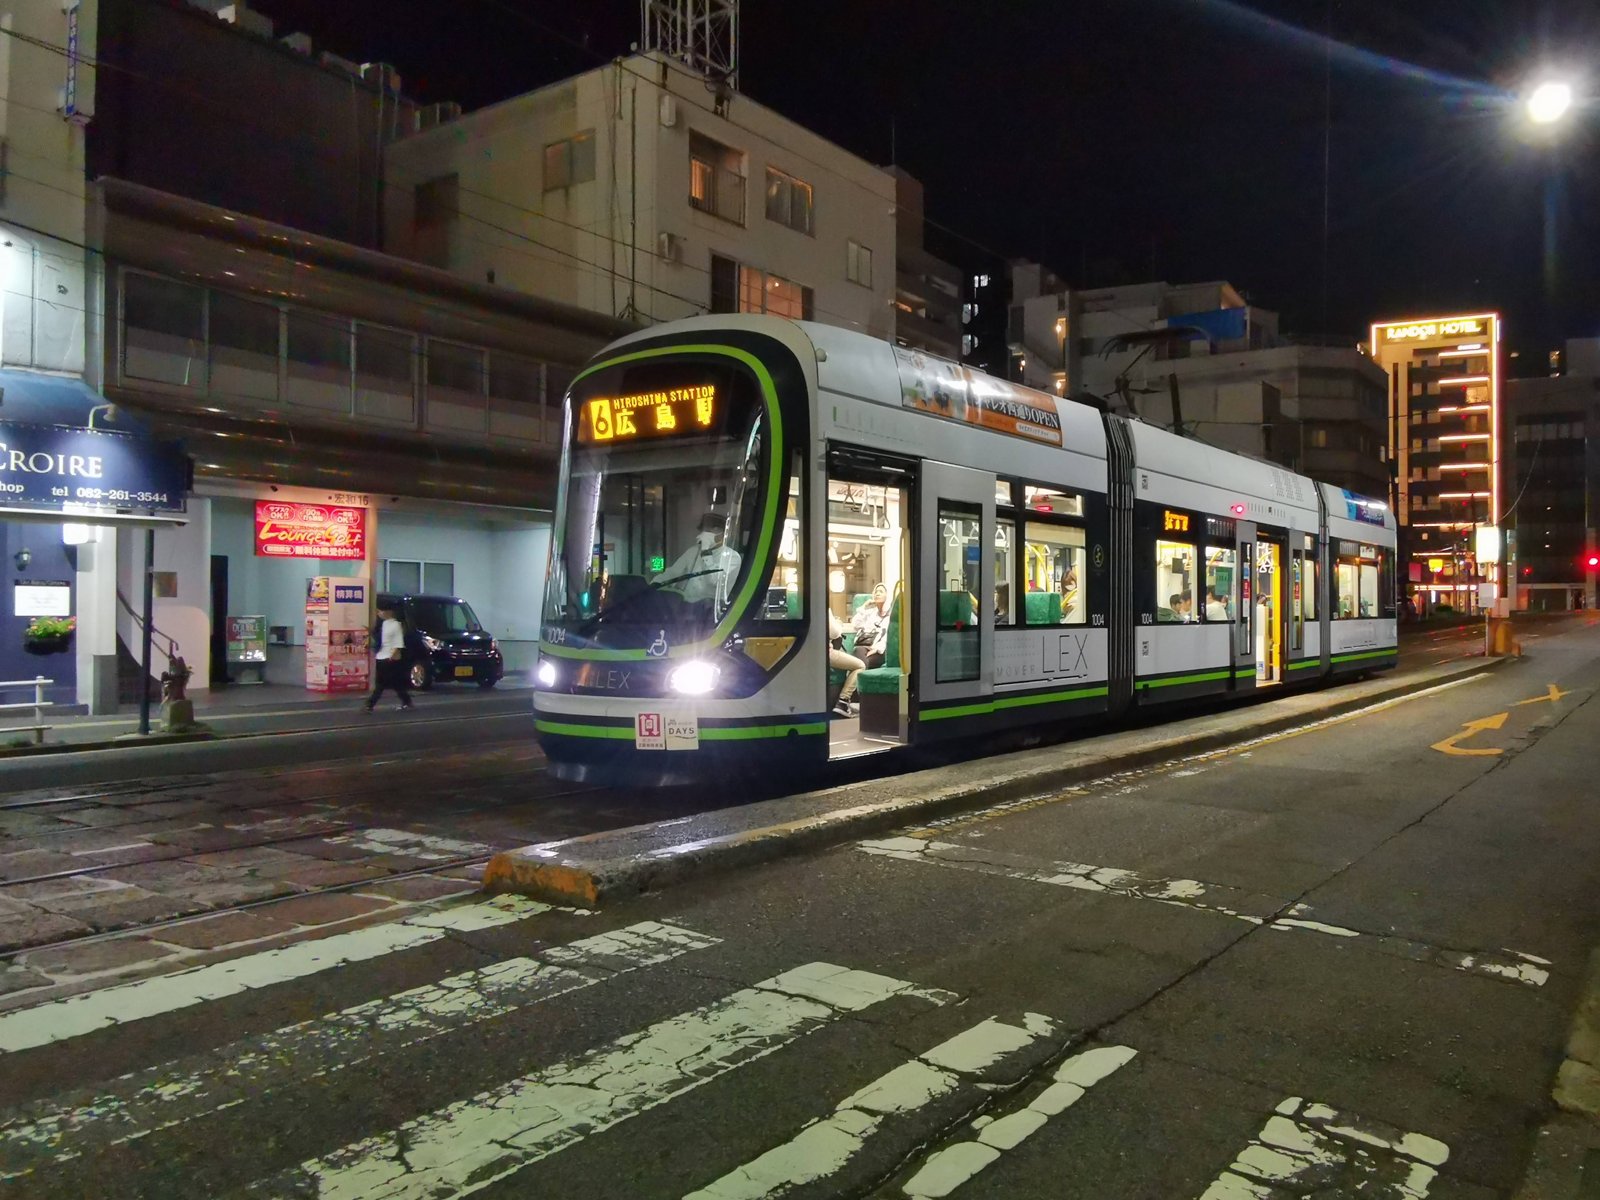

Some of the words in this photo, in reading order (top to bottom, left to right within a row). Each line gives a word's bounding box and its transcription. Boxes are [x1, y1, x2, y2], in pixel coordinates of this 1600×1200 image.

[1439, 320, 1482, 335] HOTEL
[613, 392, 668, 410] HIROSHIMA
[670, 385, 715, 402] STATION
[594, 403, 610, 436] 6
[51, 486, 69, 497] tel
[76, 487, 168, 502] 082-261-3544
[259, 520, 323, 545] LOUNGE
[1091, 613, 1105, 626] 1004
[1141, 613, 1153, 625] 1004
[547, 627, 566, 644] 1004
[1042, 633, 1088, 674] LEX
[596, 670, 632, 689] LEX
[668, 726, 696, 736] DAYS
